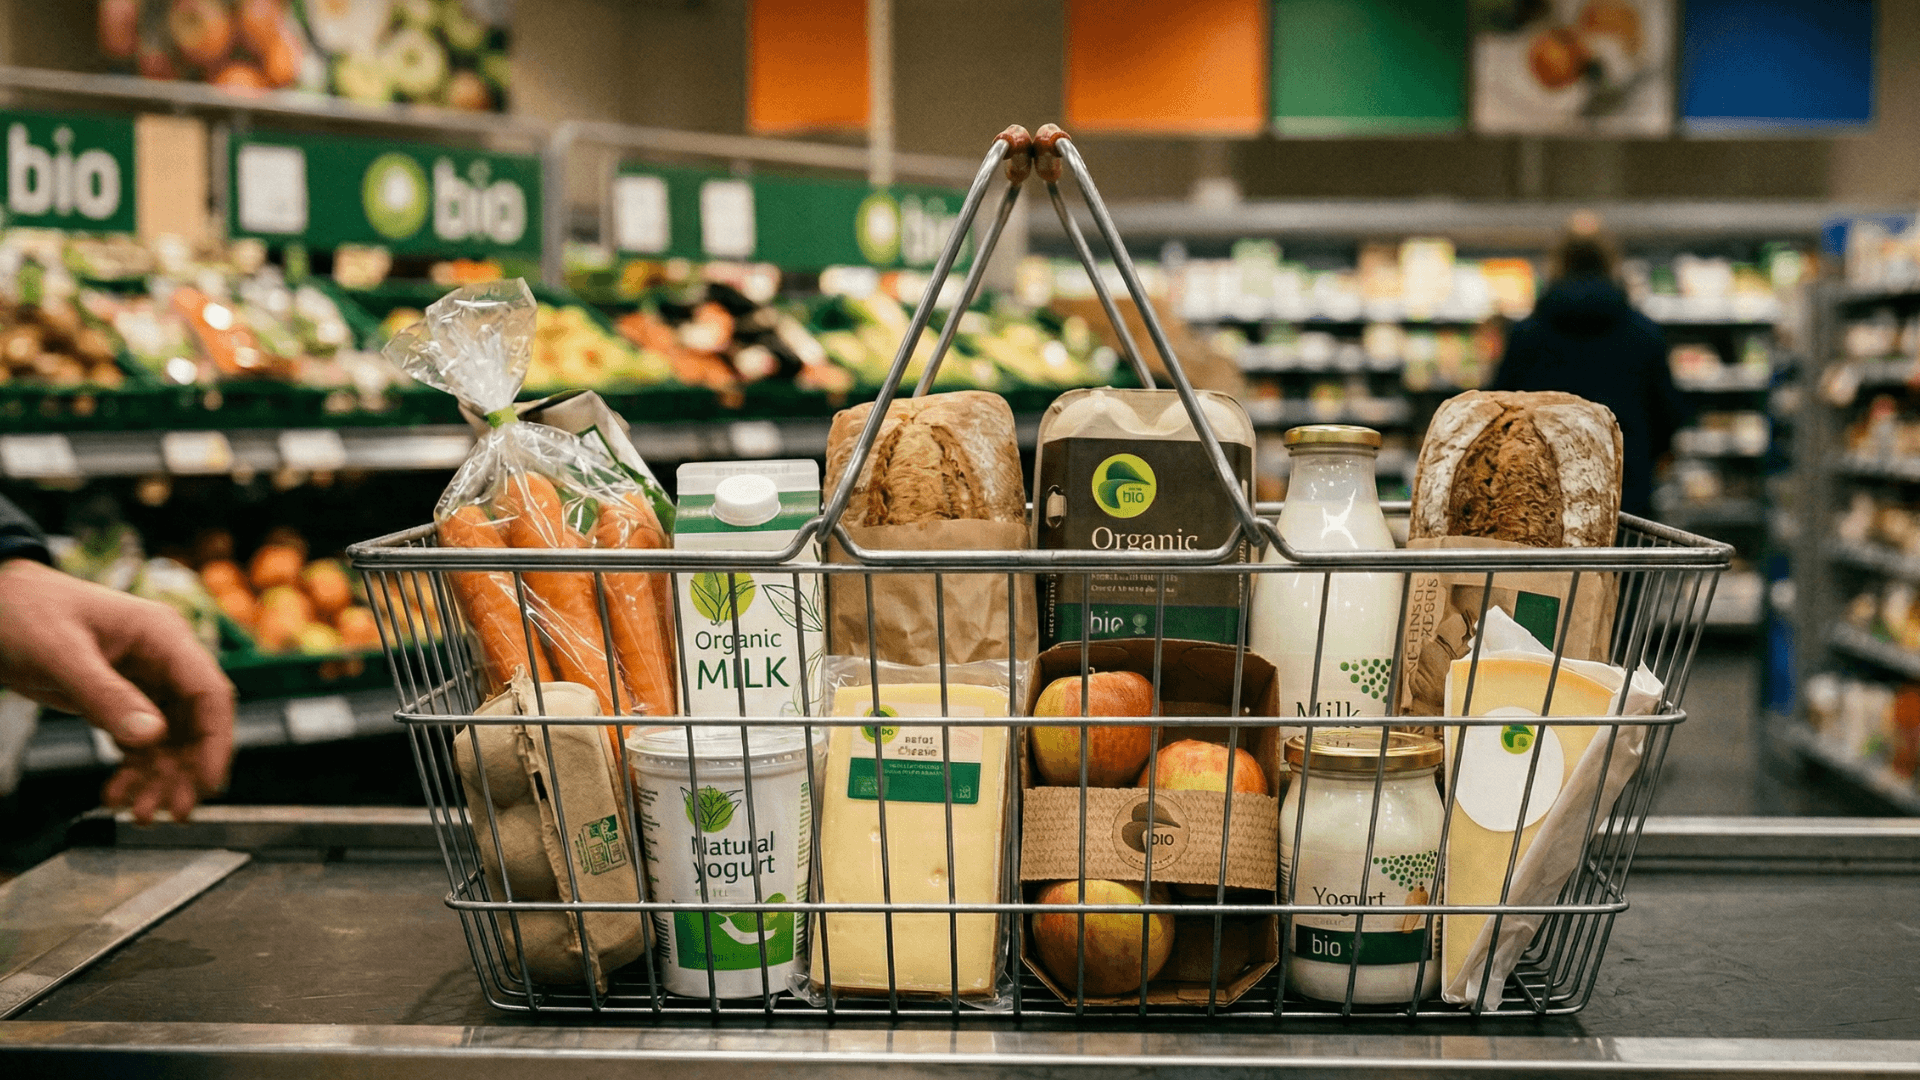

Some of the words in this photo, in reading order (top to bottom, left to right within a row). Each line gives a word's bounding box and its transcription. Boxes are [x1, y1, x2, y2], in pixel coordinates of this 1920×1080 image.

[8, 121, 121, 219] bio
[432, 155, 528, 245] bio
[1123, 490, 1144, 503] bio
[1091, 526, 1198, 550] Organic
[695, 628, 782, 655] Organic
[697, 656, 790, 690] MILK
[1296, 701, 1362, 727] Milk
[691, 830, 774, 856] Natural
[693, 854, 775, 884] yogurt
[1312, 933, 1342, 957] bio
